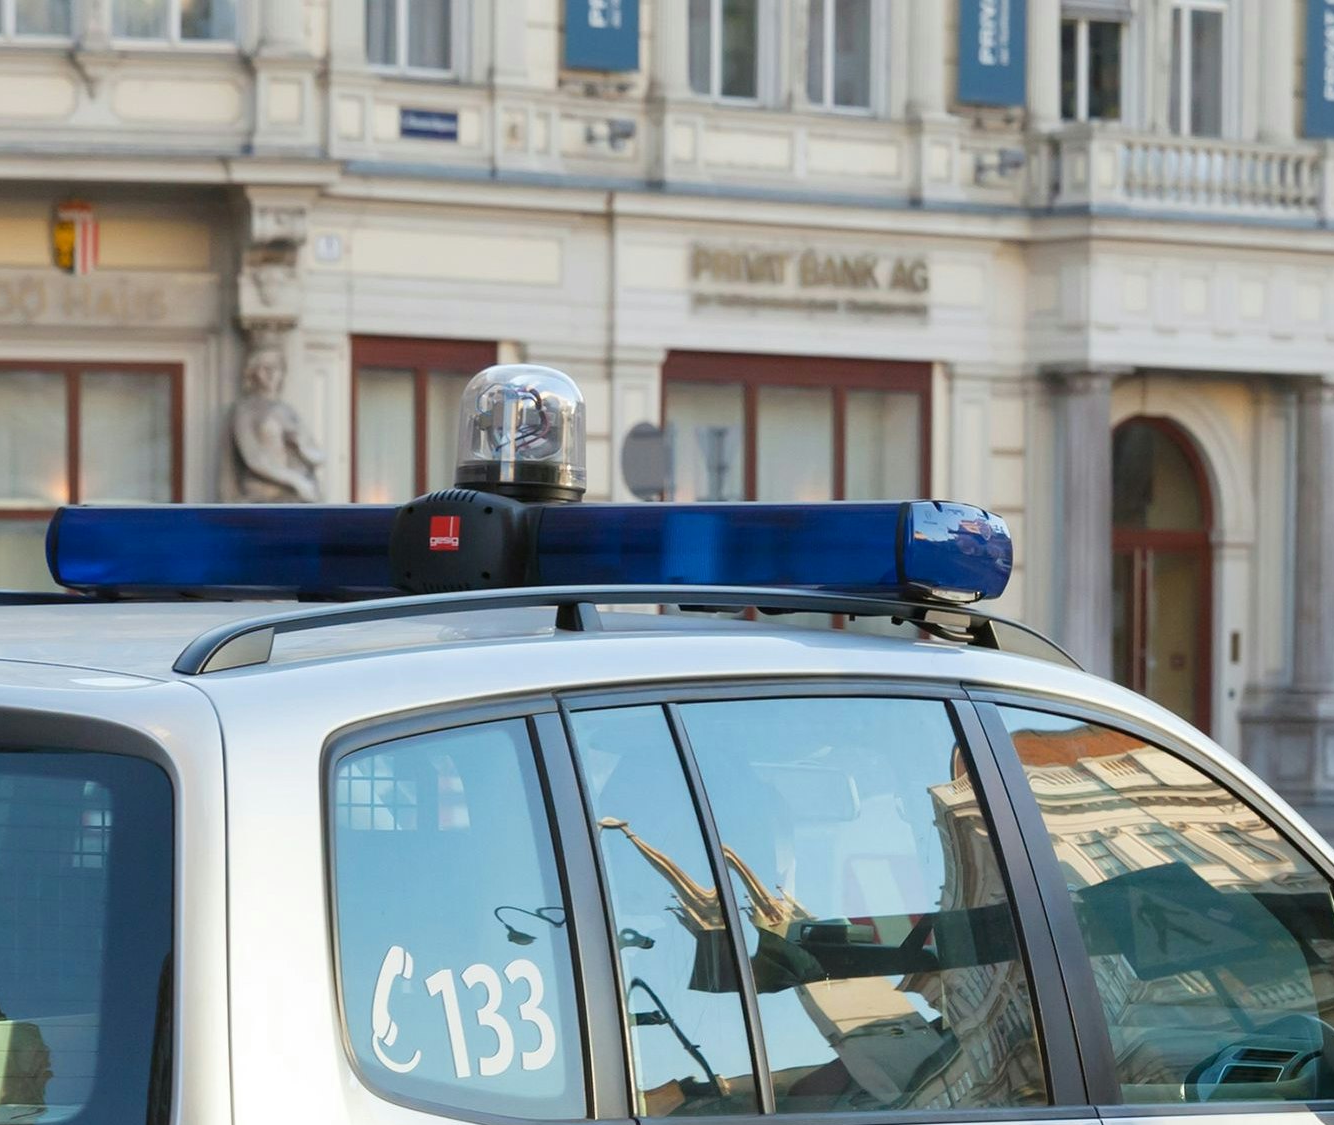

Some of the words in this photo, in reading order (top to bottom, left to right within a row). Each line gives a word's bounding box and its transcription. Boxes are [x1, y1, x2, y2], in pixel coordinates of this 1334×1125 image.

[692, 244, 791, 285] PRIVAT
[799, 248, 880, 289] BANK
[889, 255, 929, 294] AG
[429, 536, 460, 547] gesig
[425, 957, 557, 1079] 133
